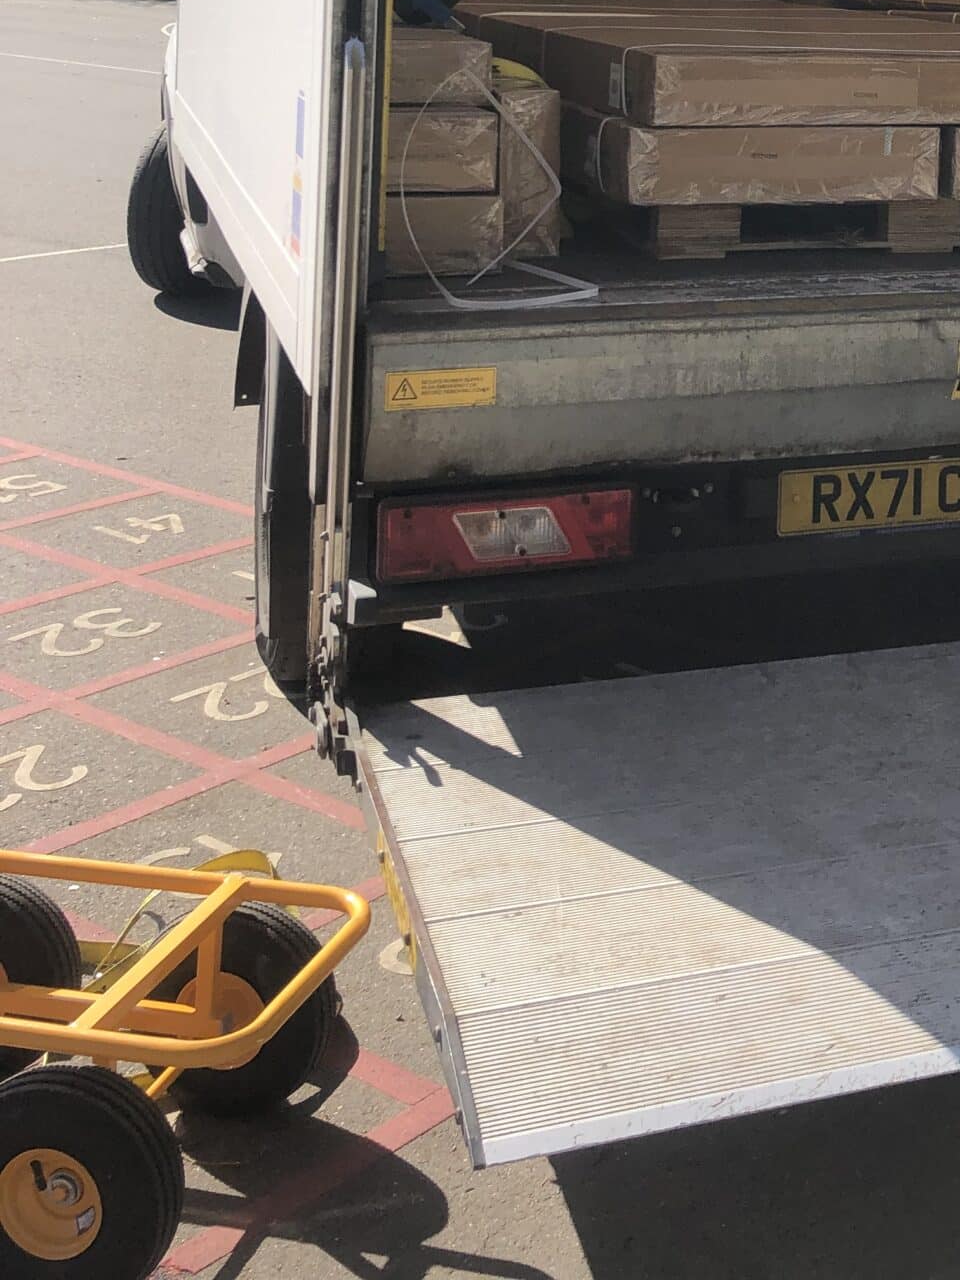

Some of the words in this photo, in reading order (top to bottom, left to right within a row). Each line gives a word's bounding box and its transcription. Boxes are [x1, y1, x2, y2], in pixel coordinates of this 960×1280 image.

[811, 467, 923, 524] RX71
[92, 511, 185, 545] 41
[7, 607, 163, 658] 32
[0, 743, 88, 812] 2
